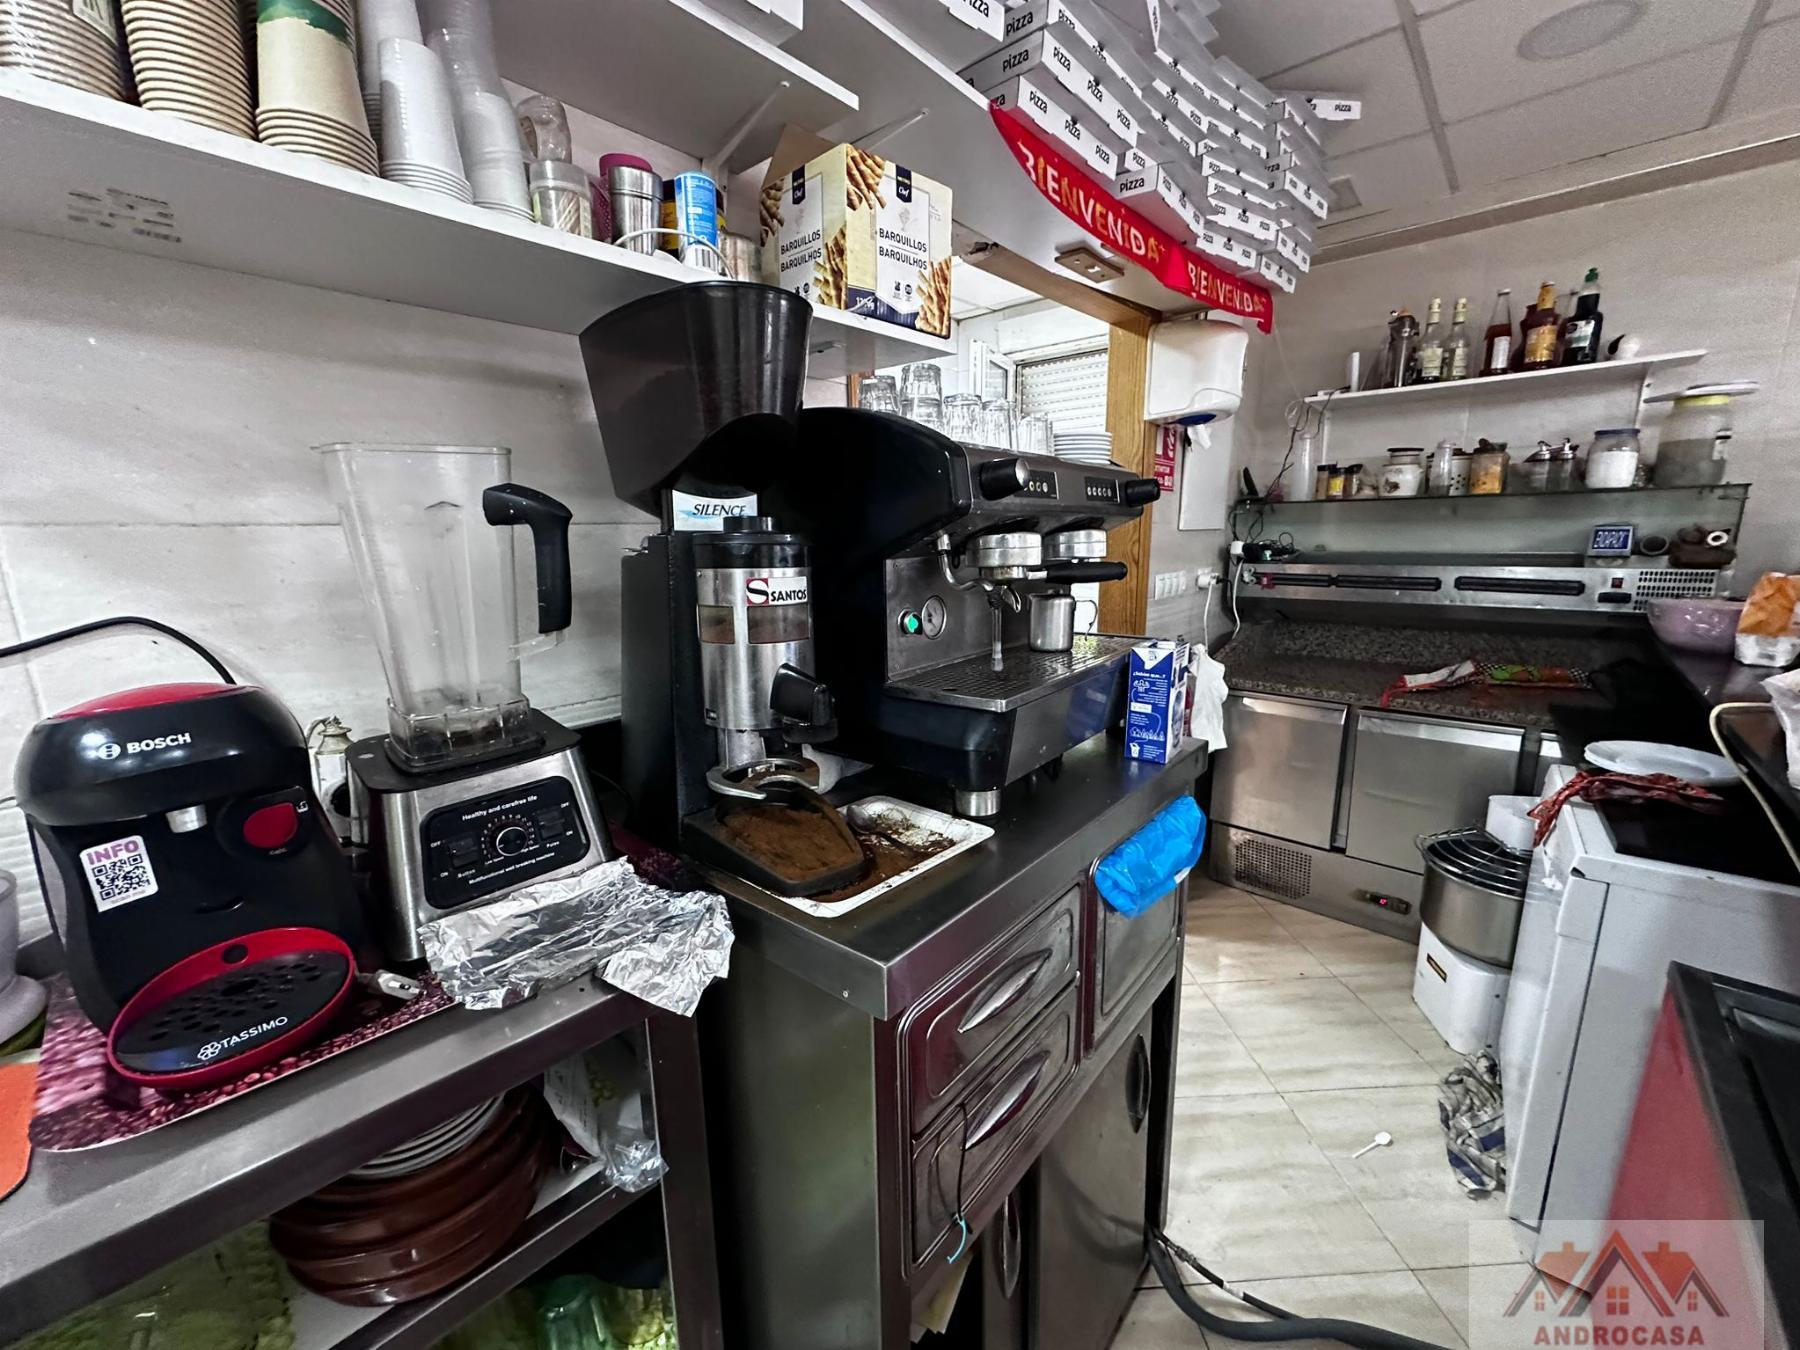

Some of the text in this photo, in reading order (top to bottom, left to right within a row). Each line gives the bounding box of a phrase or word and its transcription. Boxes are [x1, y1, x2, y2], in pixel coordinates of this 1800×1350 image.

[1006, 11, 1034, 36] pizza
[1002, 49, 1029, 72] pizza
[1053, 46, 1071, 72] pizza
[1087, 79, 1103, 102] pizza
[1117, 108, 1131, 130] pizza
[1334, 102, 1352, 112] pizza
[1029, 90, 1048, 114] pizza
[1065, 119, 1081, 140] pizza
[1096, 145, 1110, 164] pizza
[1119, 177, 1145, 193] pizza
[780, 229, 822, 255] BARQUILLOS
[878, 227, 928, 253] BARQUILLOS
[780, 247, 823, 273] BARQUILHOS
[878, 245, 928, 271] BARQUILHOS
[692, 503, 746, 516] SILENCE
[770, 589, 807, 603] SANTOS
[126, 732, 192, 754] BOSCH
[488, 805, 501, 813] and
[86, 840, 140, 865] INFO
[218, 1016, 288, 1049] TASSIMO
